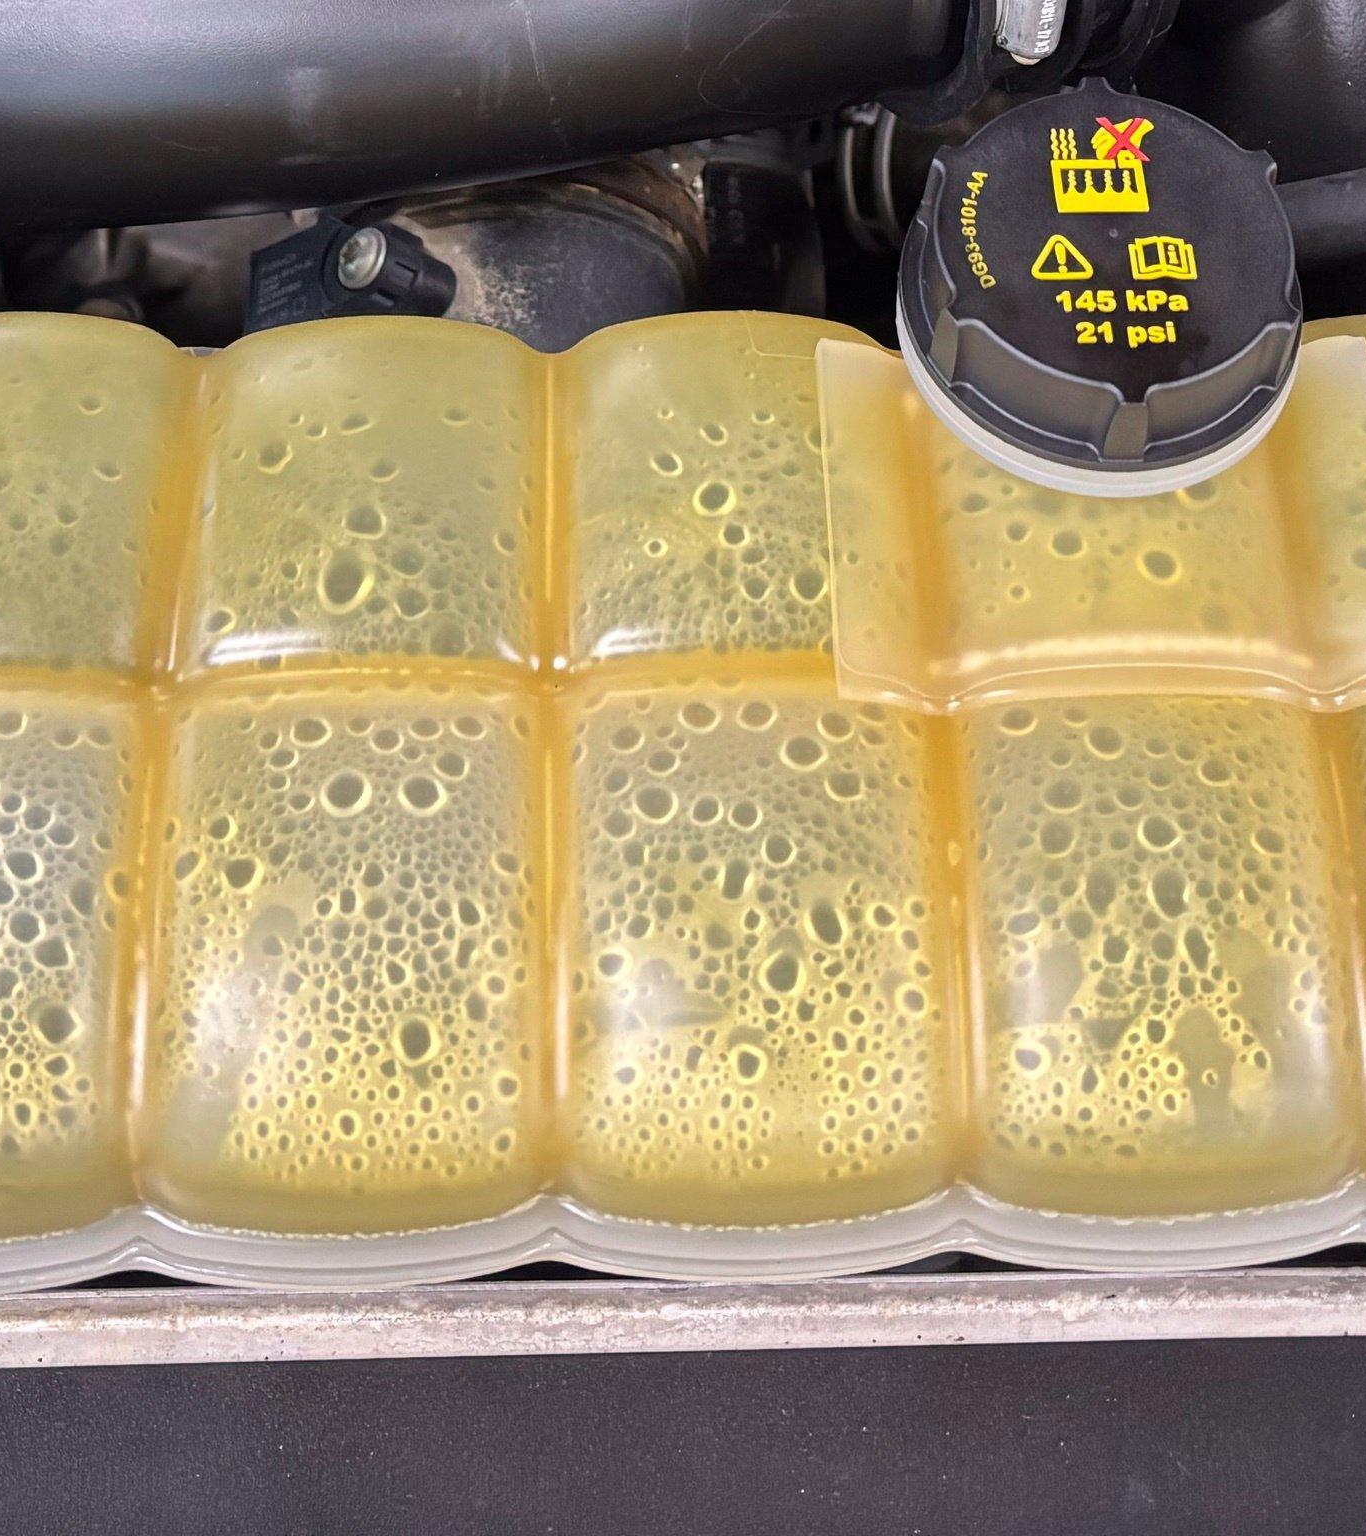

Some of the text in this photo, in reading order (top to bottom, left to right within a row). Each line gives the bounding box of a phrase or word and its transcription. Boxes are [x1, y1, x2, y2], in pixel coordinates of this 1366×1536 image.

[960, 170, 997, 290] DG93-8101-AA
[1055, 289, 1190, 314] 145 kPa
[1075, 320, 1178, 349] 21 psi
